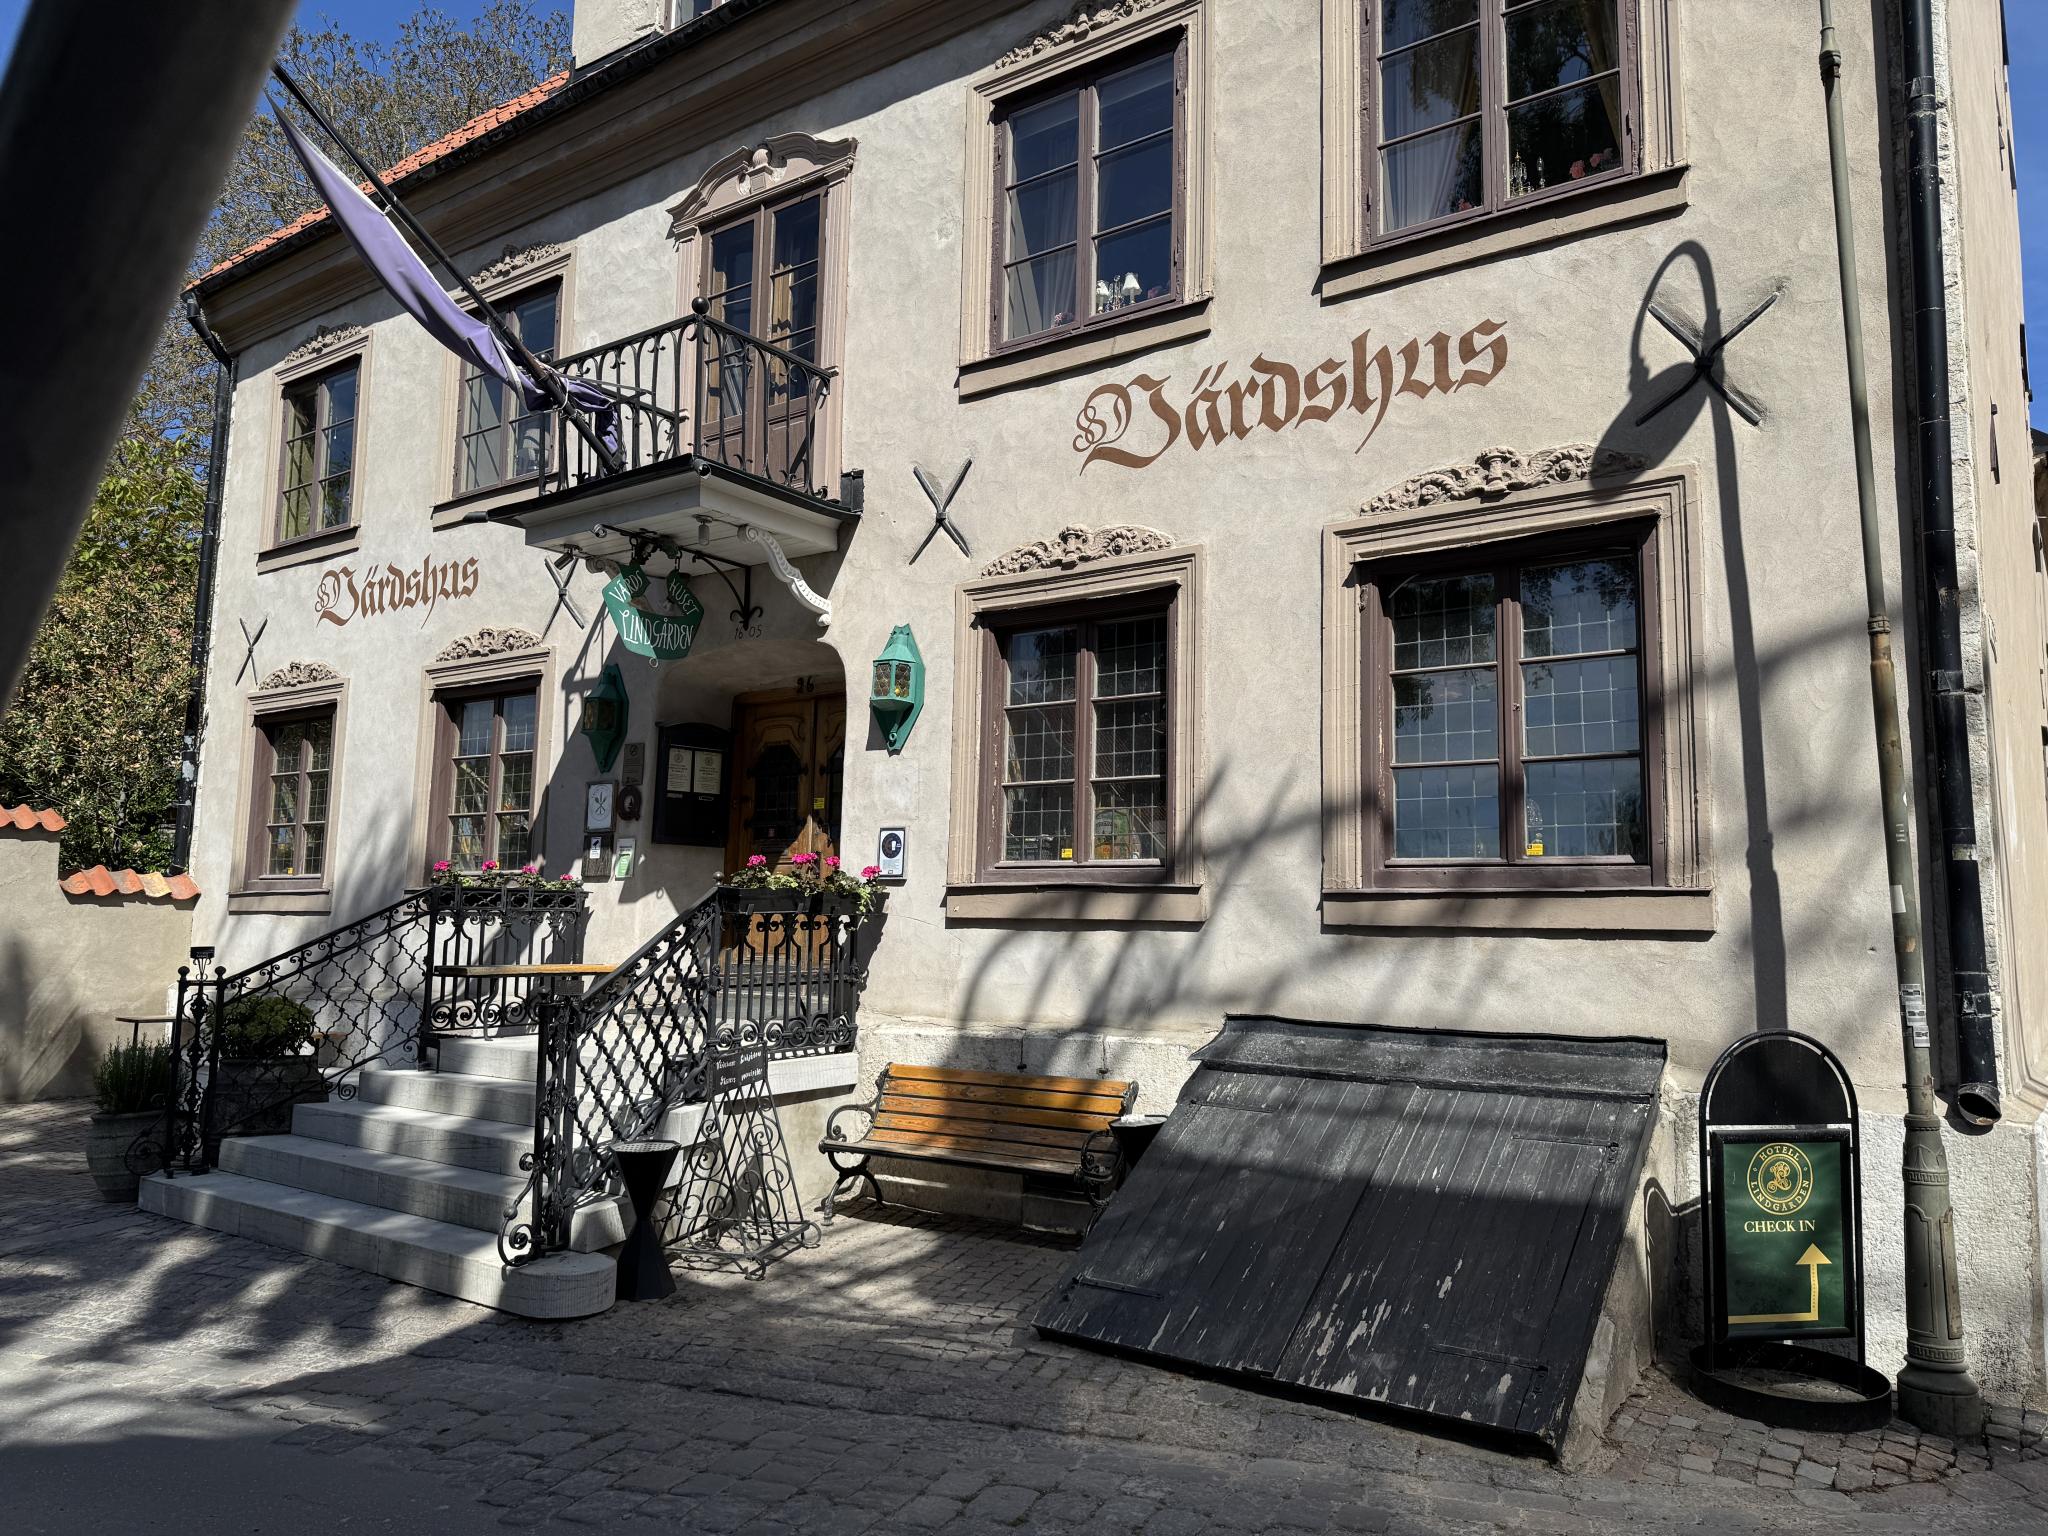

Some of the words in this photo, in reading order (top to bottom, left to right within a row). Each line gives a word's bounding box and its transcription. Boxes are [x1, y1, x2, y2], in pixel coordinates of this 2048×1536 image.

[1072, 318, 1508, 476] Värdshus
[314, 552, 480, 630] Värdshus
[669, 578, 699, 615] HUSET
[619, 608, 694, 650] LINDGÅRDEN
[1759, 1146, 1800, 1161] HOTELL
[1751, 1180, 1809, 1211] LINDGÅRDEN
[1744, 1220, 1796, 1232] CHECK
[1799, 1220, 1815, 1232] IN
